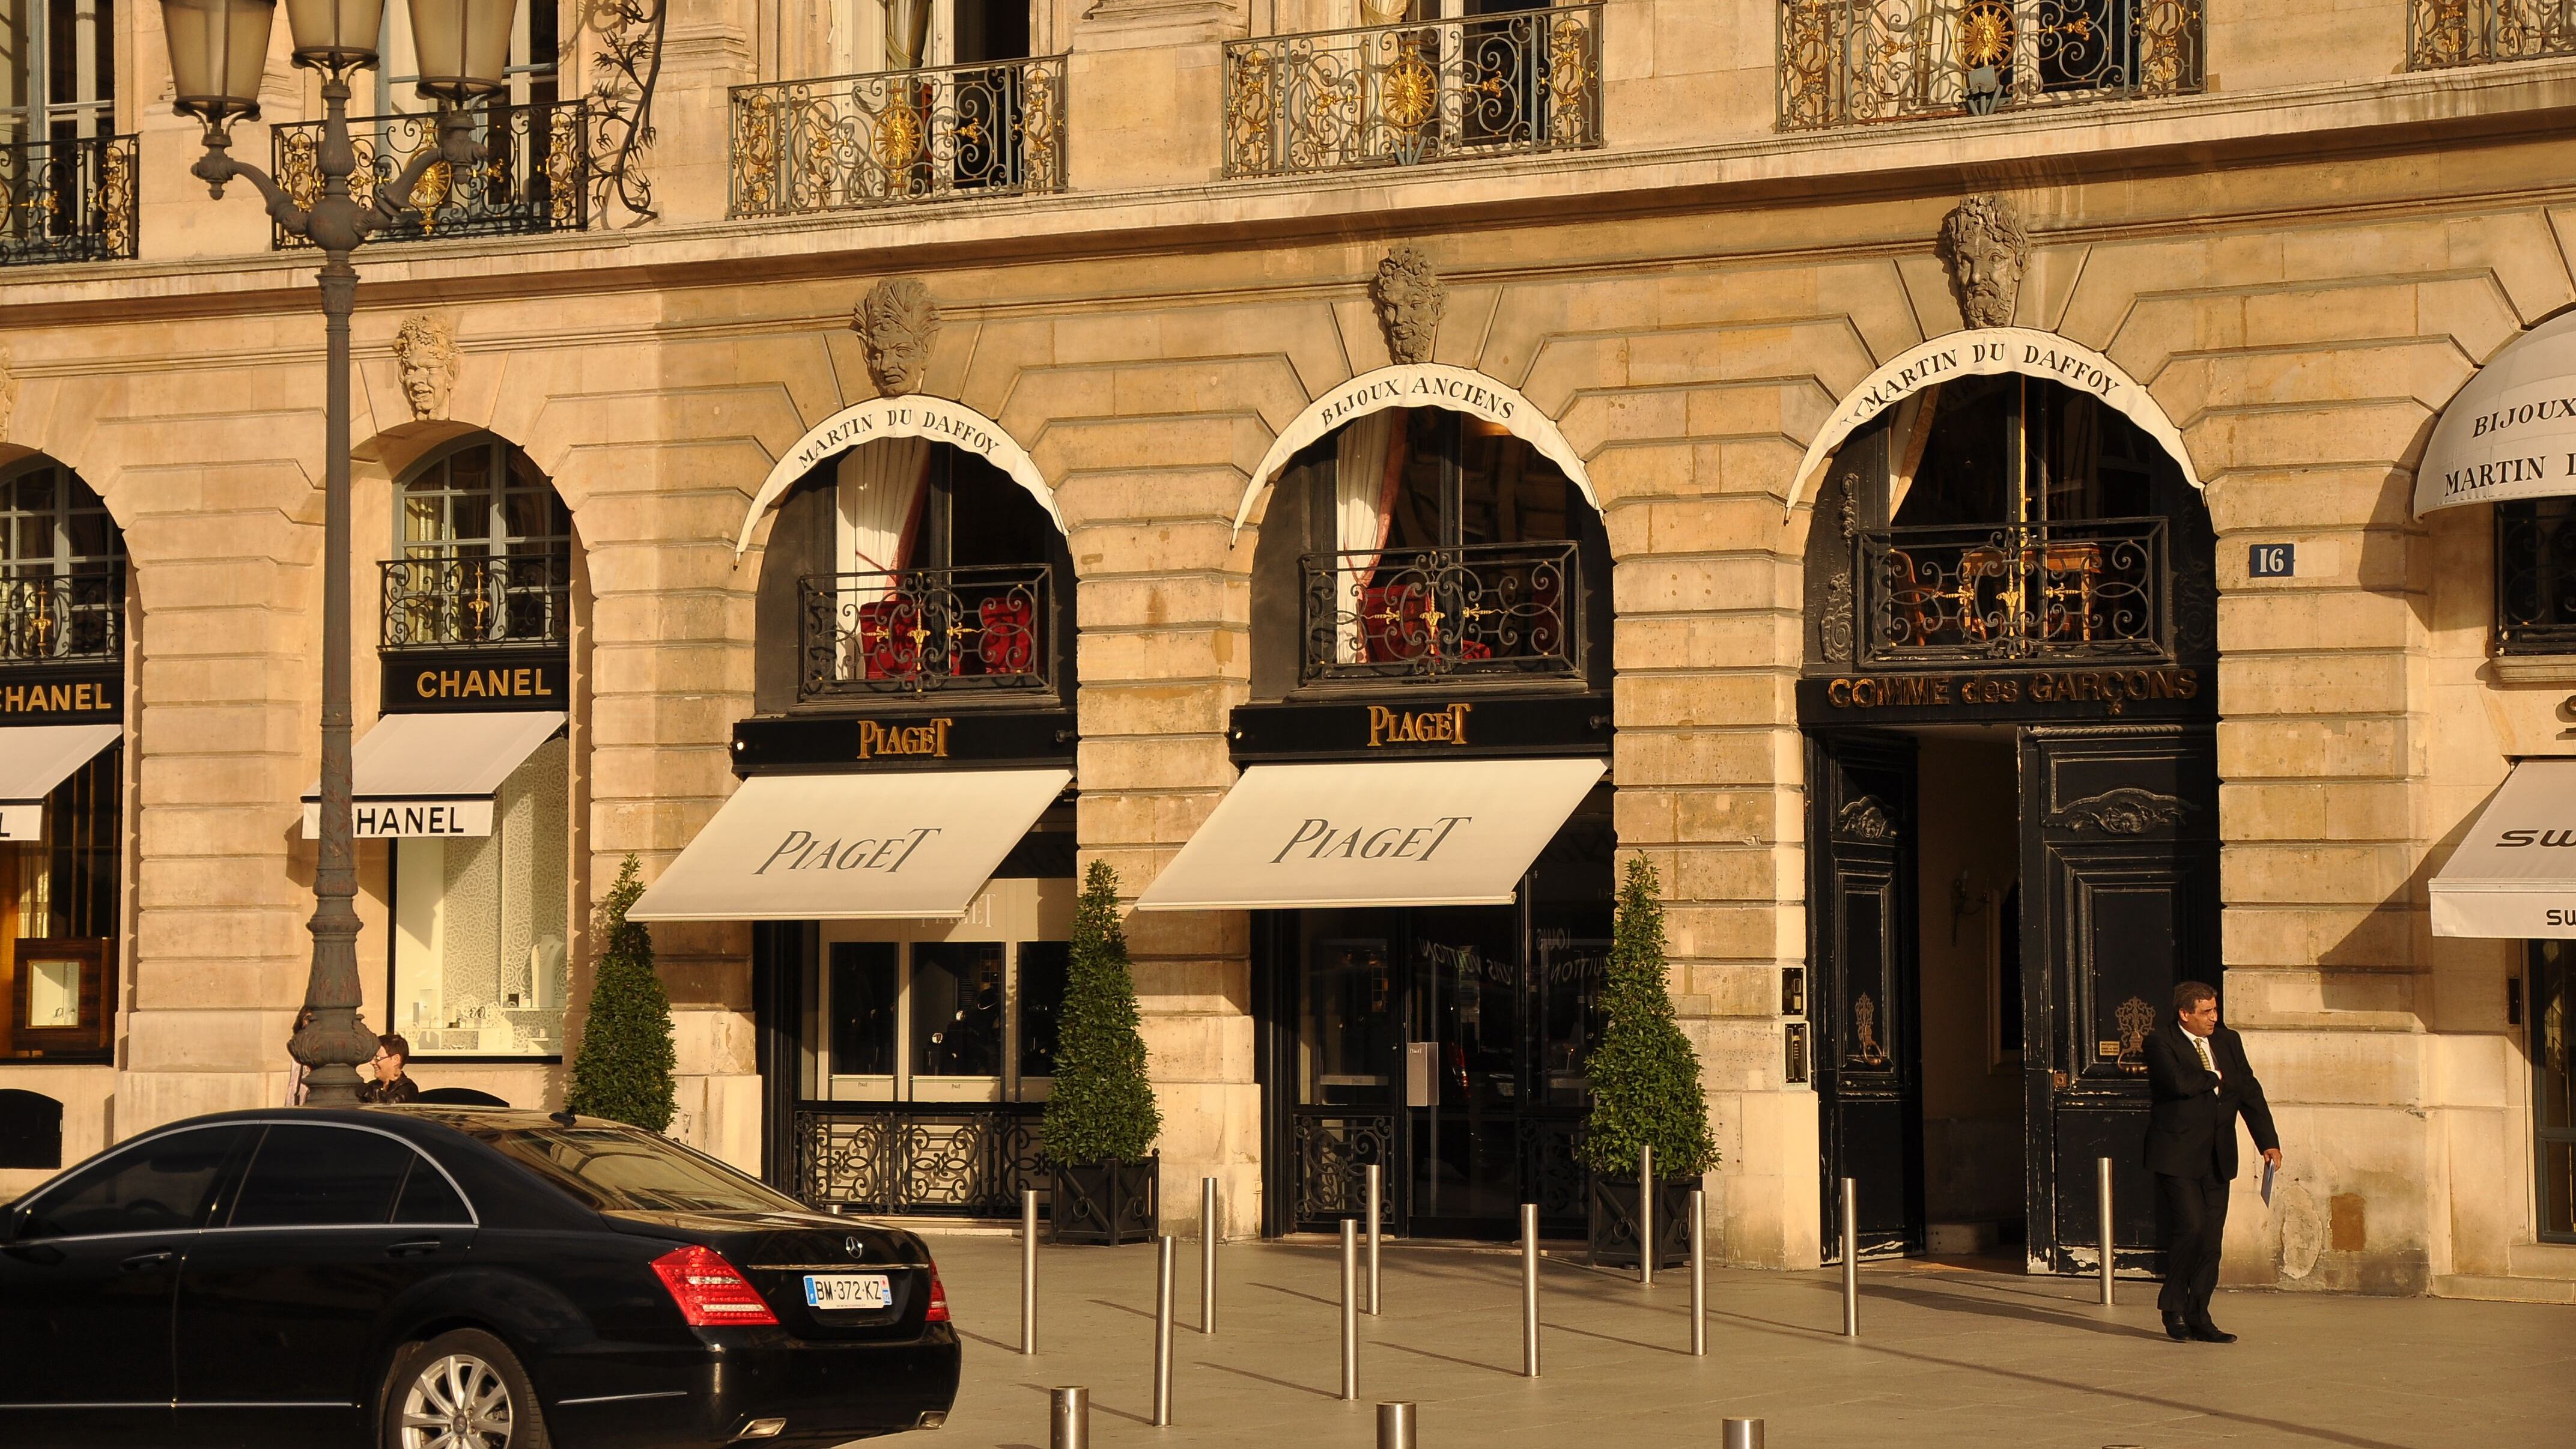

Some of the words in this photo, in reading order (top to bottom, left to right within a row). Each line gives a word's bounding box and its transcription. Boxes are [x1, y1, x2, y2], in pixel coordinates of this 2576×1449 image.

[1862, 348, 1957, 413] MARTIN
[1972, 343, 2005, 363] DU
[2023, 344, 2121, 398] DAFFOY
[1320, 378, 1402, 427] BIJOUX
[1411, 377, 1516, 420] ANCIENS
[2471, 398, 2576, 439] BIJOUX
[797, 413, 873, 470] MARTIN
[887, 409, 913, 427] DU
[922, 411, 1001, 457] DAFFOY
[2444, 455, 2547, 497] MARTIN
[2259, 548, 2284, 573] 16
[0, 683, 112, 712] HANEL
[416, 668, 551, 699] CHANEL
[1827, 675, 1951, 708] COMME
[1961, 673, 2019, 704] des
[856, 718, 954, 759] PIAGET
[1367, 702, 1472, 747] PIAGET
[356, 806, 464, 834] HANEL
[1269, 816, 1473, 864] PIAGET
[752, 827, 943, 875] PIAGET
